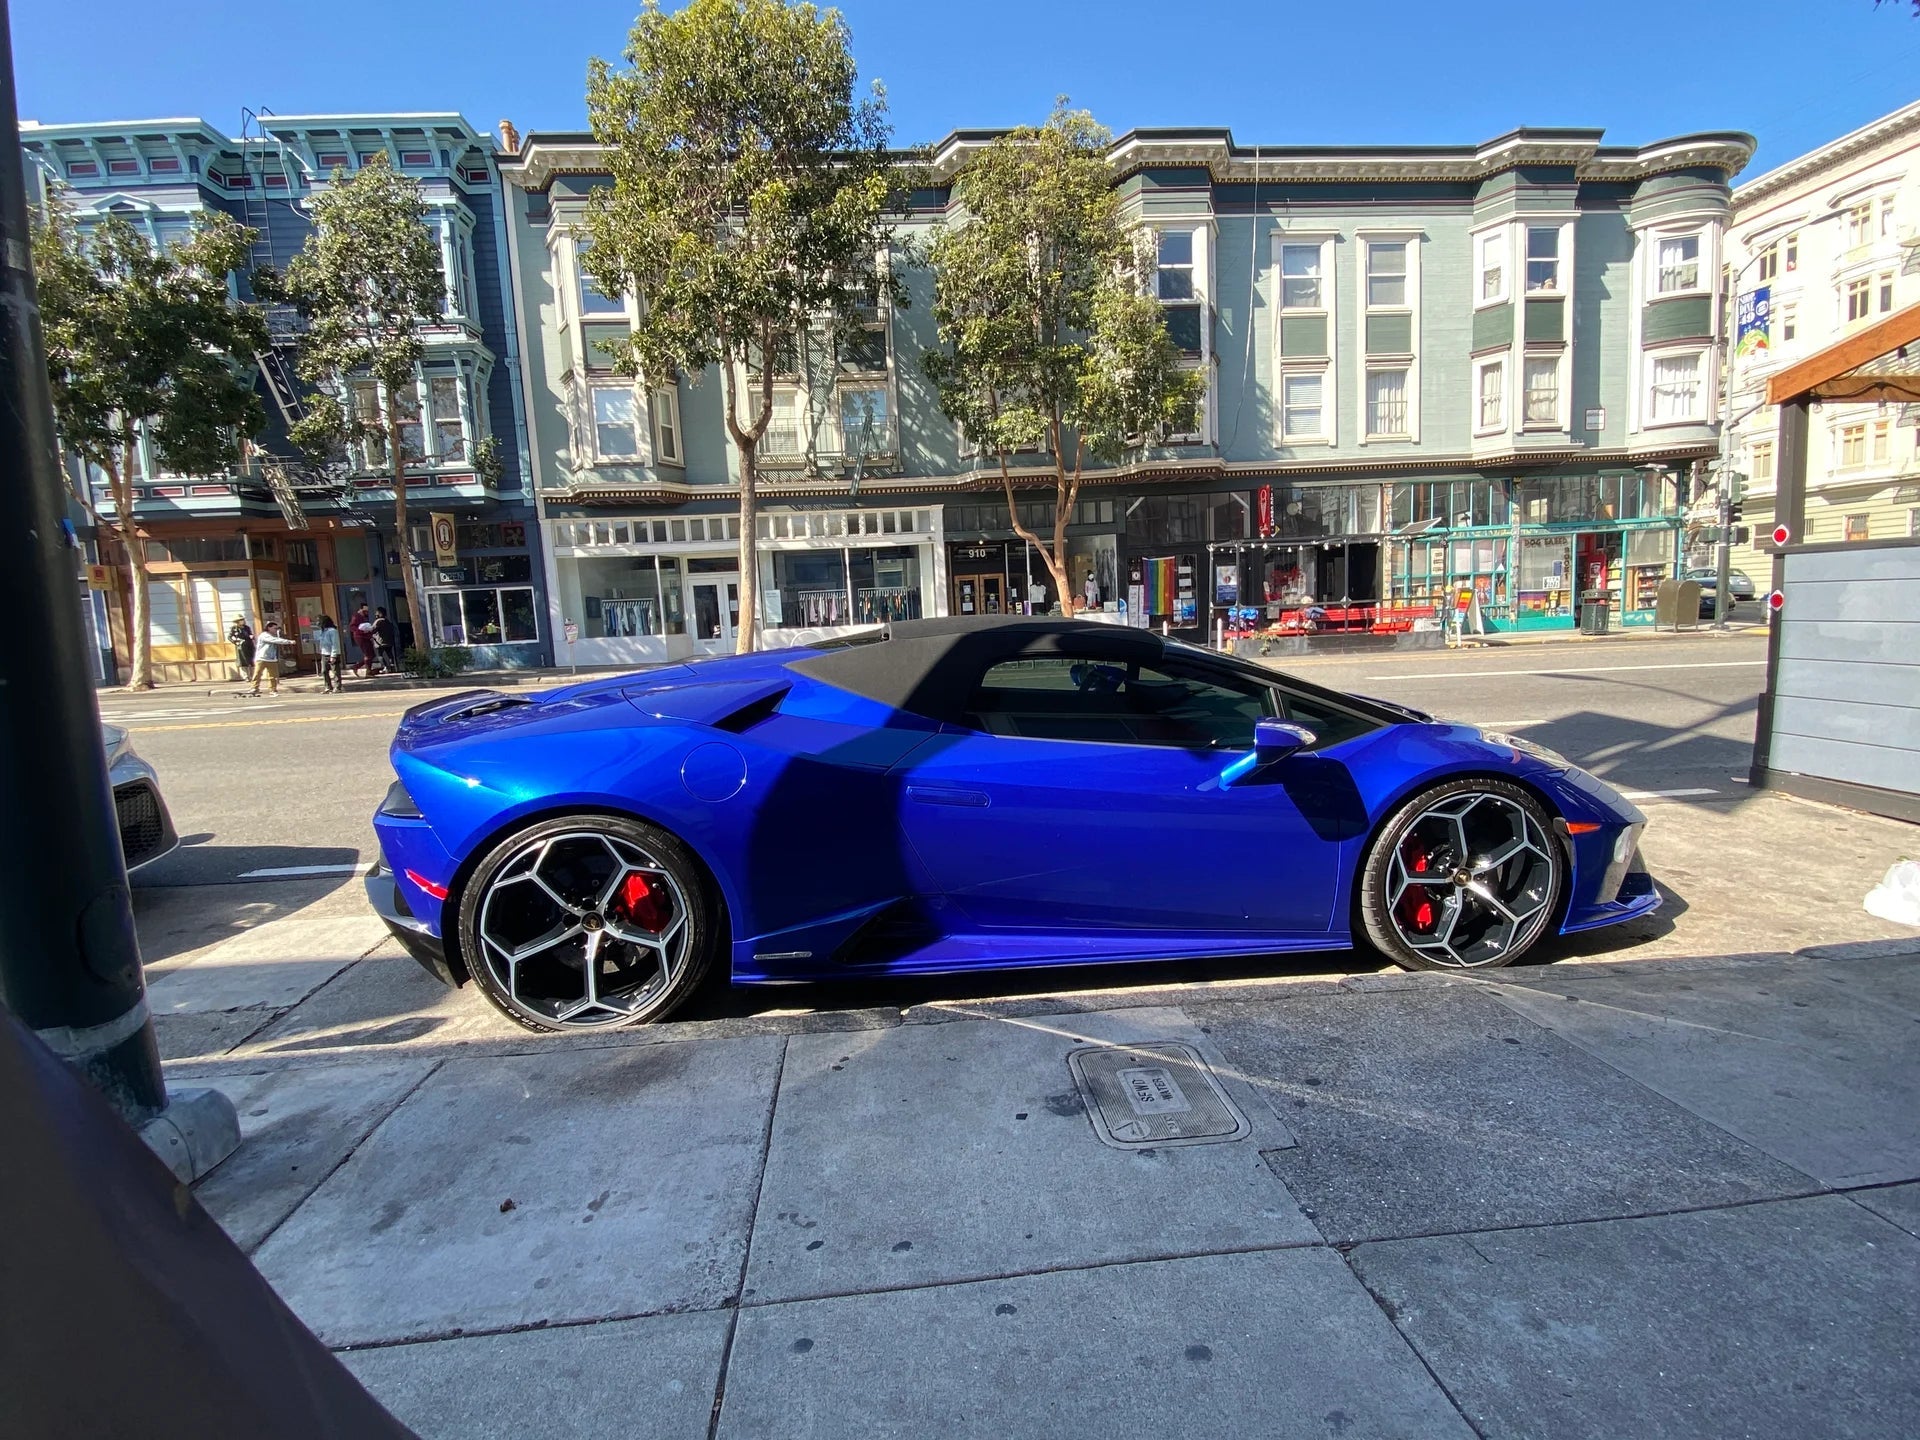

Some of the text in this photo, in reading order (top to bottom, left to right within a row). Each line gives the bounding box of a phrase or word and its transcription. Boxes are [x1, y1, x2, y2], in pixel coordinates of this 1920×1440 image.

[1524, 536, 1568, 547] DOG EARED
[968, 549, 986, 558] 910
[440, 572, 464, 582] OPEN
[1152, 1078, 1174, 1101] WATER
